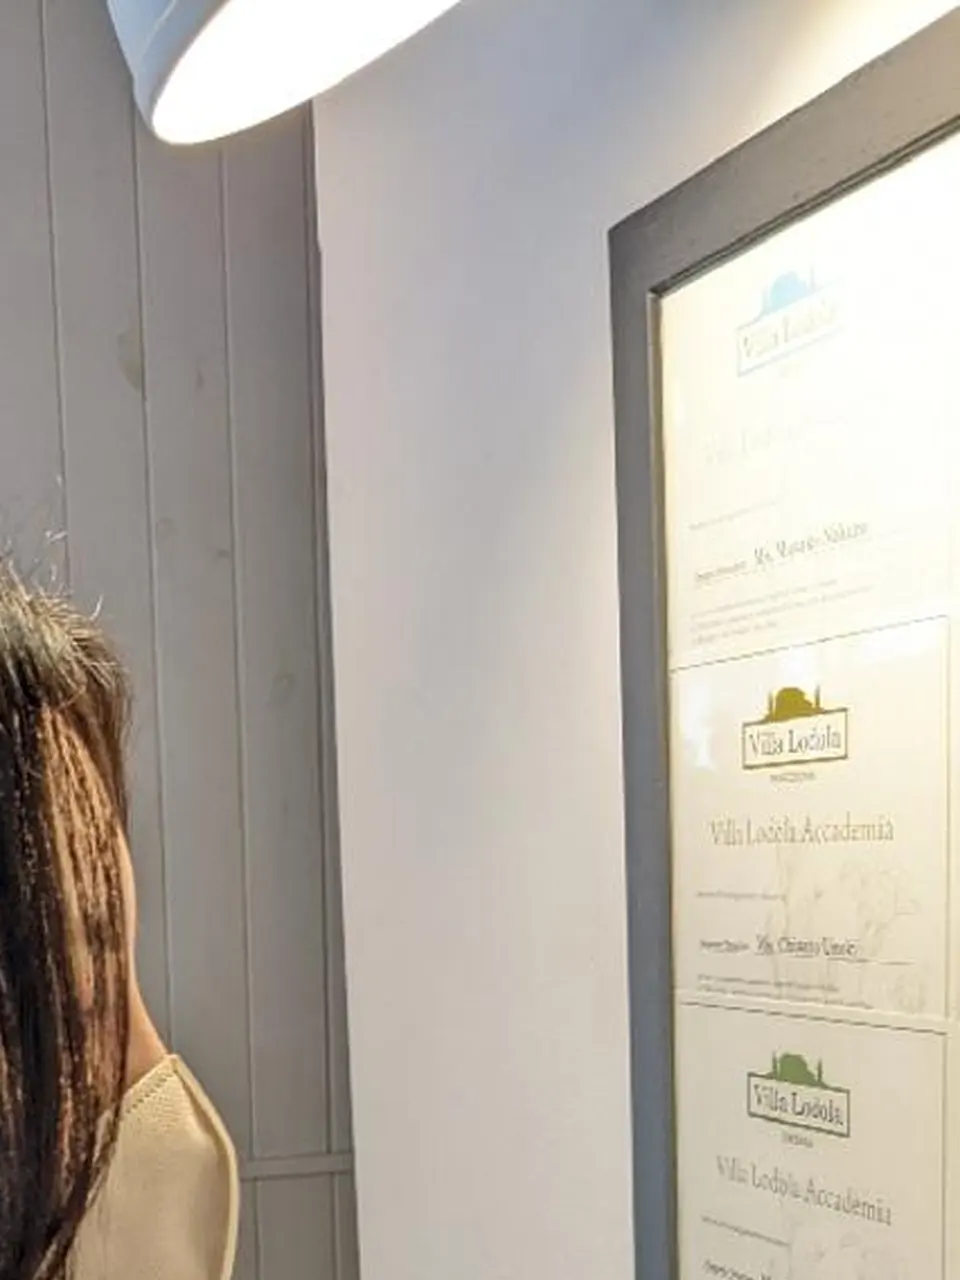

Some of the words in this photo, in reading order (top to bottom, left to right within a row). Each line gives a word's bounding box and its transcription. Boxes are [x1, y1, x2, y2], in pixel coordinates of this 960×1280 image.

[749, 730, 784, 756] Villa
[711, 817, 742, 846] Villa
[753, 1083, 788, 1113] Villa
[791, 1091, 844, 1126] Lodola
[716, 1155, 748, 1183] Villa
[802, 1178, 891, 1226] Accademia
